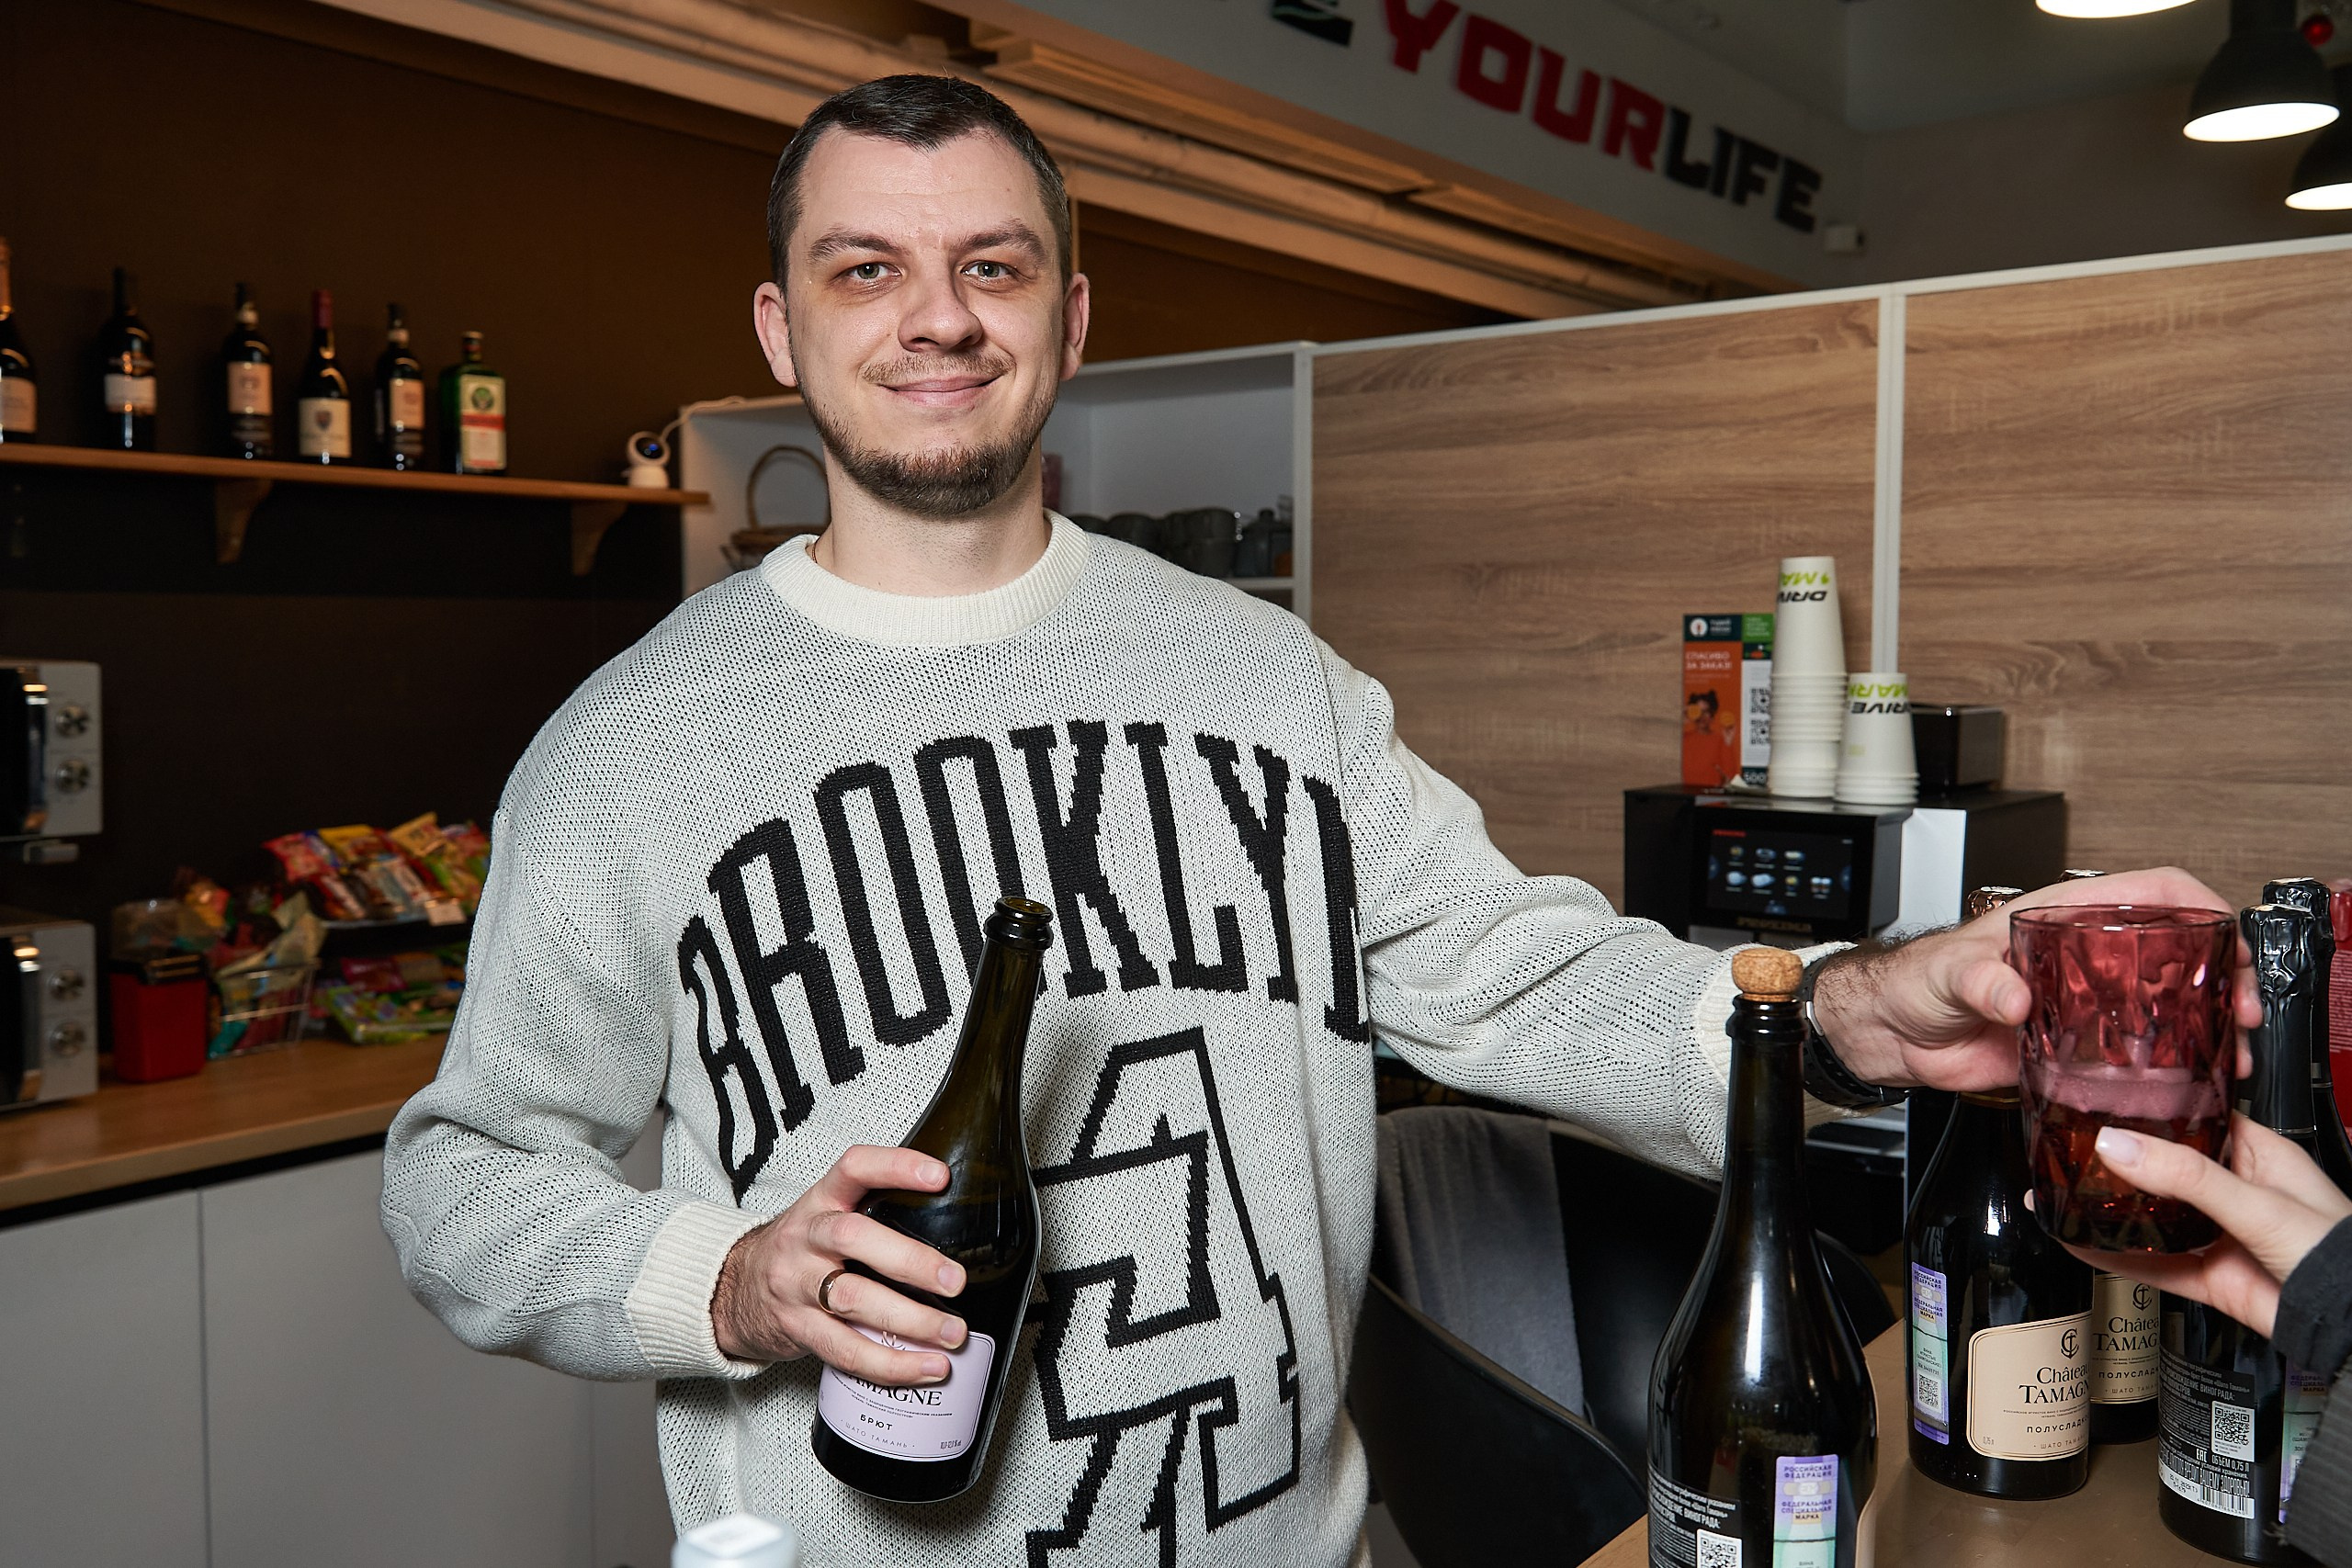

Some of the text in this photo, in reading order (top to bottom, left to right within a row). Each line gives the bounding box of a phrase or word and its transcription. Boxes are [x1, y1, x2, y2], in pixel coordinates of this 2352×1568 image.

[860, 1414, 893, 1430] БРЮТ
[845, 1422, 908, 1449] ШАТО ТАМАНЬ
[2041, 1441, 2062, 1450] ШАТО
[1784, 1471, 1832, 1479] ФЕДЕРАЦИЯ
[1781, 1499, 1832, 1507] ФЕДЕРАЛЬНАЯ
[1781, 1506, 1832, 1514] СПЕЦИАЛЬНАЯ
